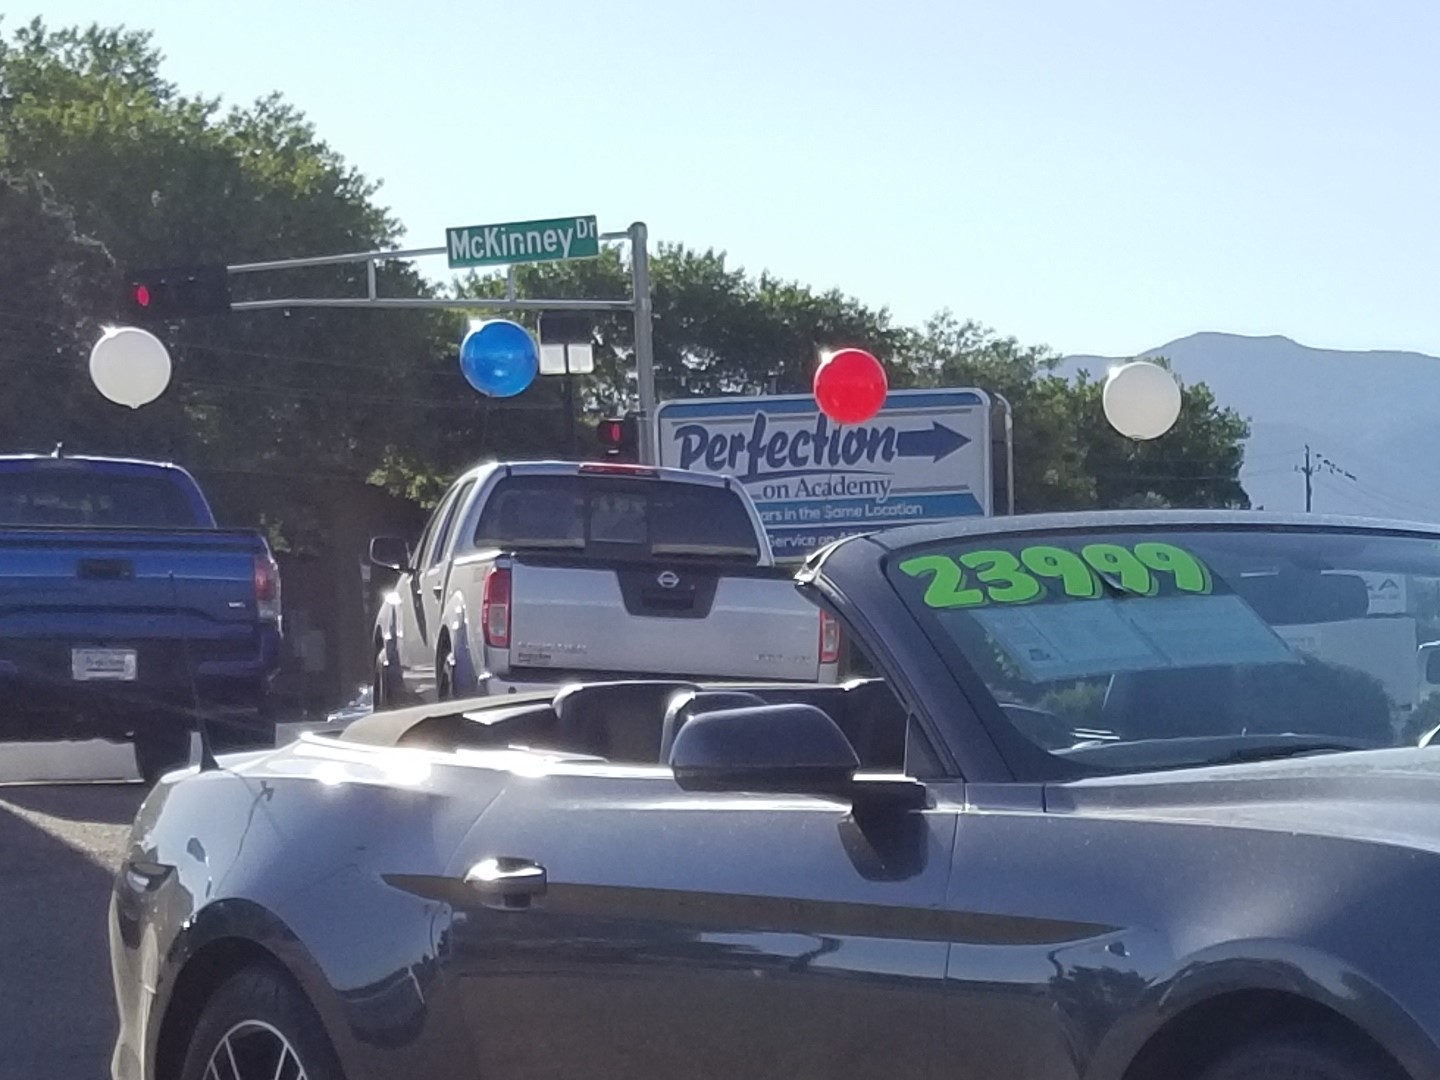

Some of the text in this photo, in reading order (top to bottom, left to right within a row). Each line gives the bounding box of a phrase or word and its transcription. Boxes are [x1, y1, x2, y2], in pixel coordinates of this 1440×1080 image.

[450, 218, 596, 261] McKinney Dr
[673, 411, 897, 476] Perfection
[763, 476, 892, 503] on Academy
[785, 509, 797, 520] in
[800, 507, 821, 519] the
[824, 505, 862, 518] Same
[865, 503, 923, 517] Location
[900, 542, 1211, 608] 23999
